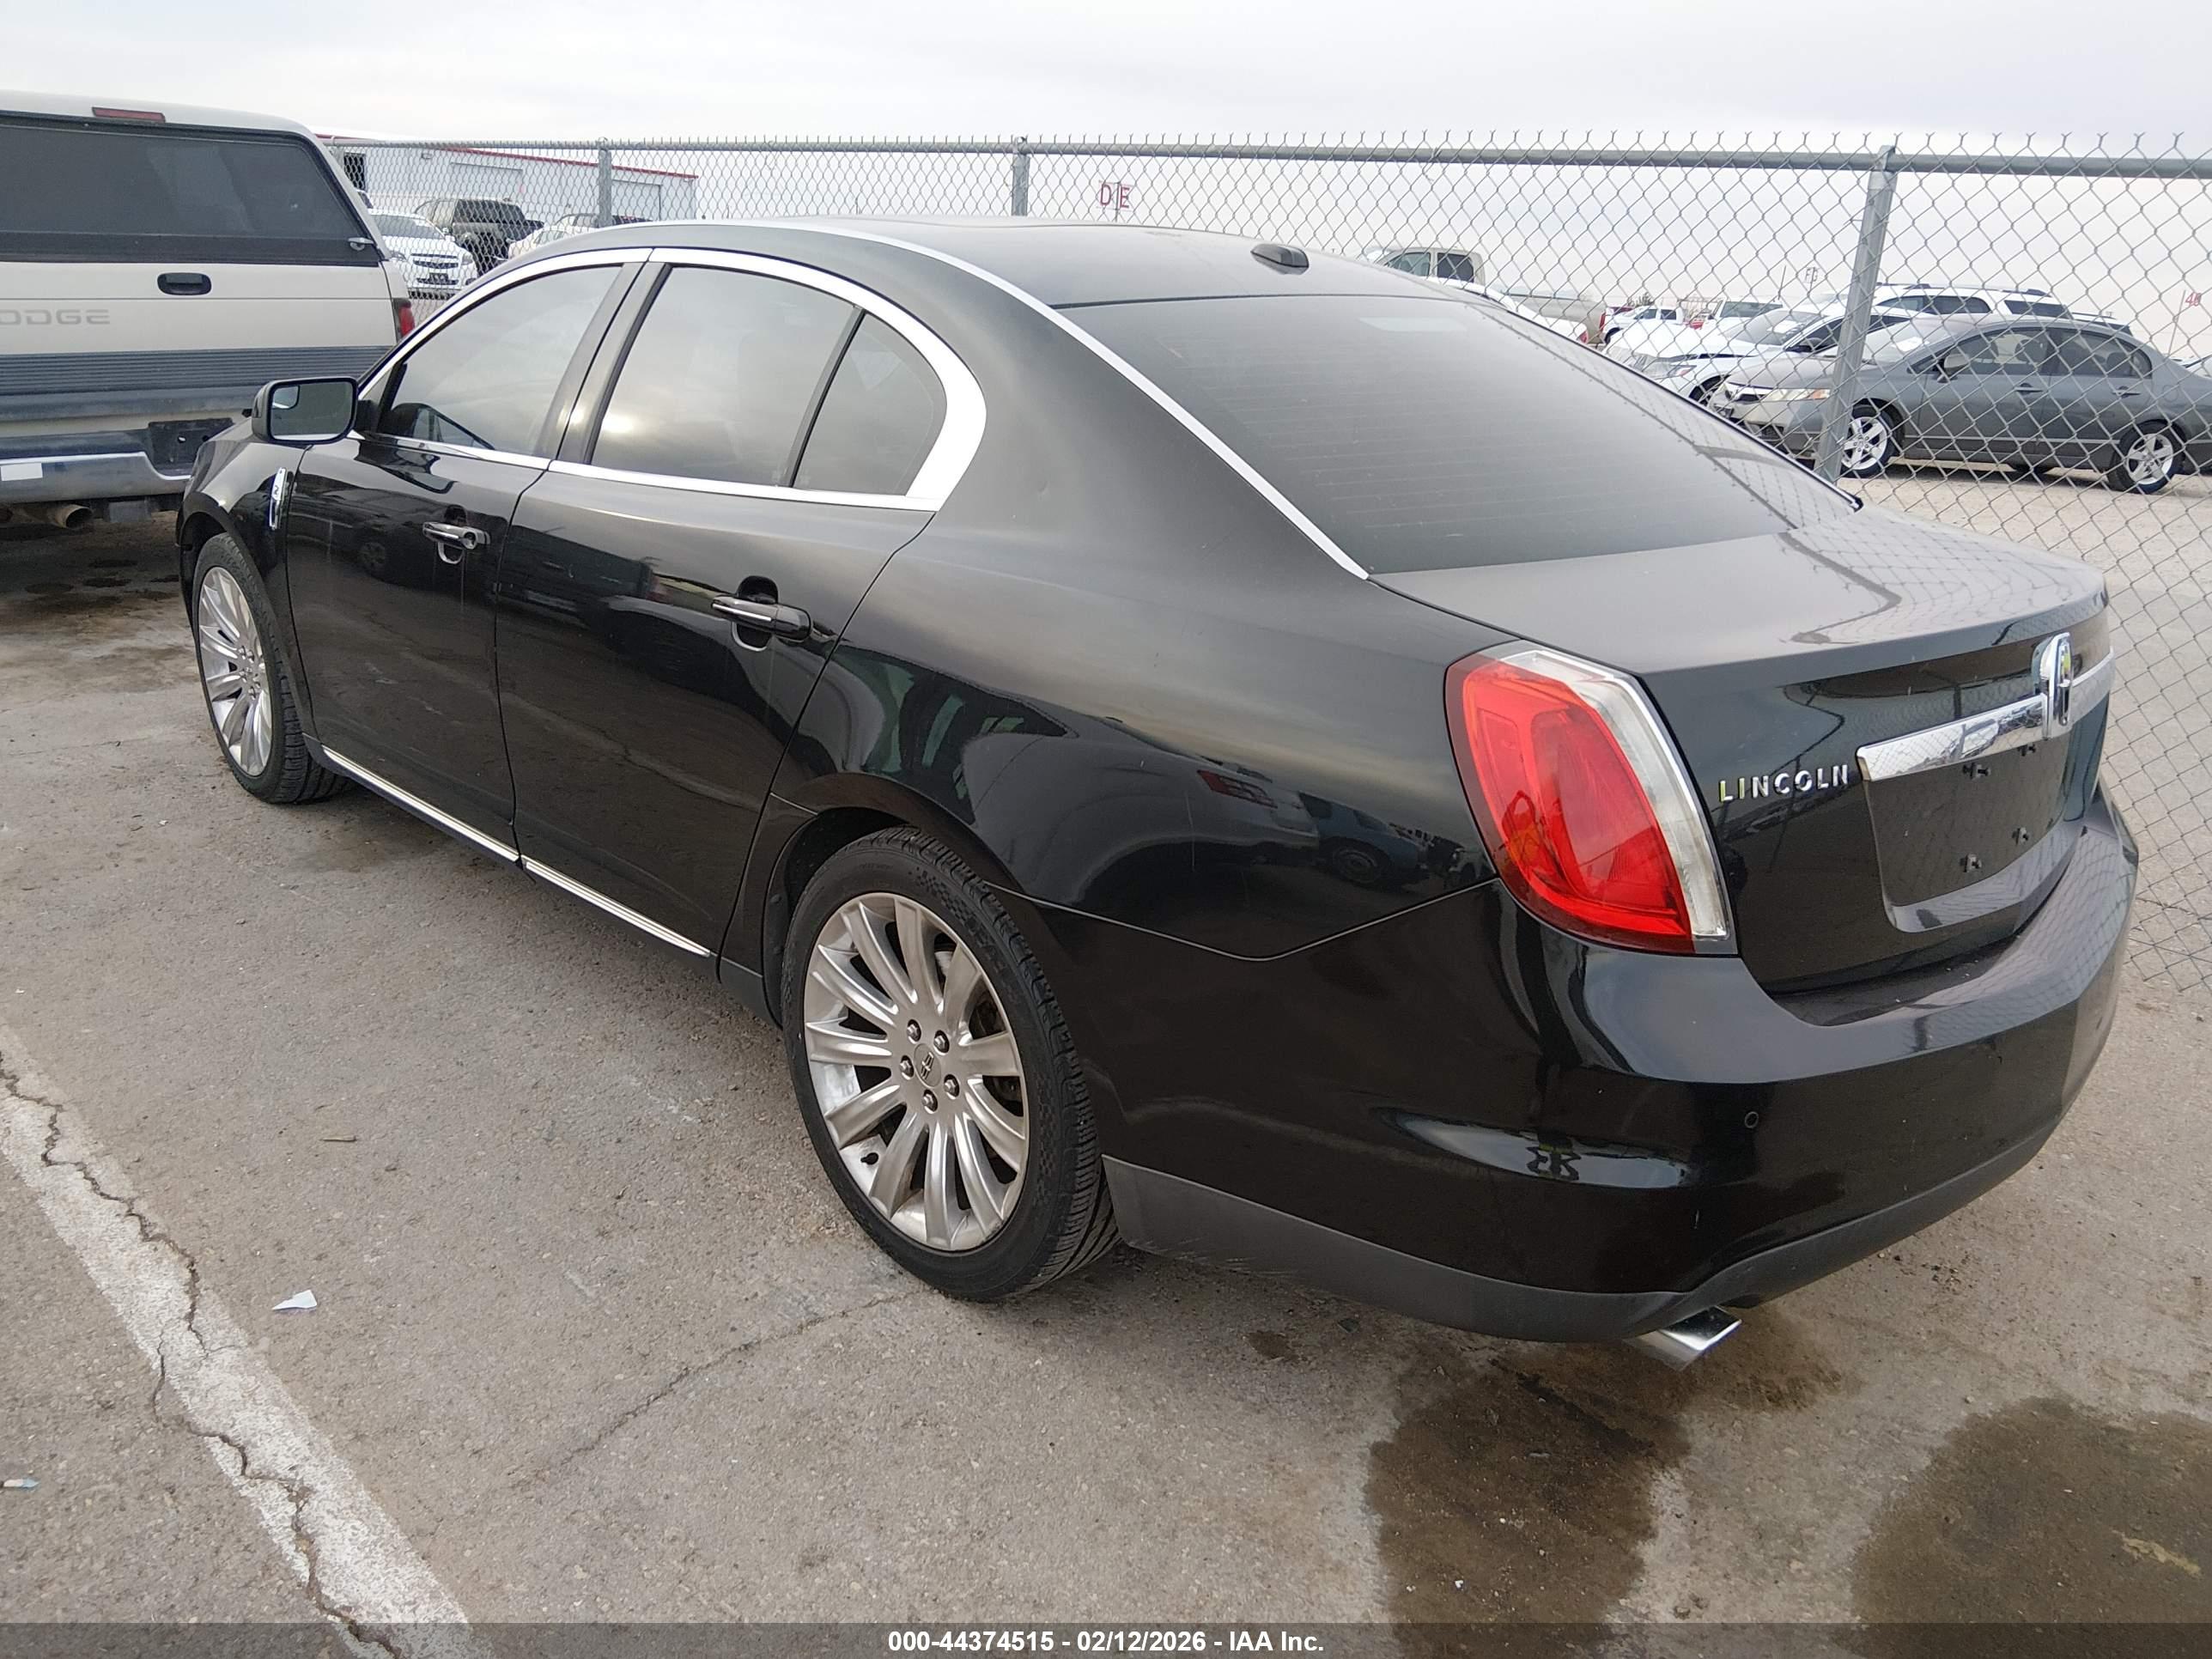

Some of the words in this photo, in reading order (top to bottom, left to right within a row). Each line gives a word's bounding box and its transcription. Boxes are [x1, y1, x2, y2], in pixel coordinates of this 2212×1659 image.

[1100, 184, 1112, 205] D
[1120, 186, 1130, 209] E
[1719, 763, 1850, 803] LINCOLN
